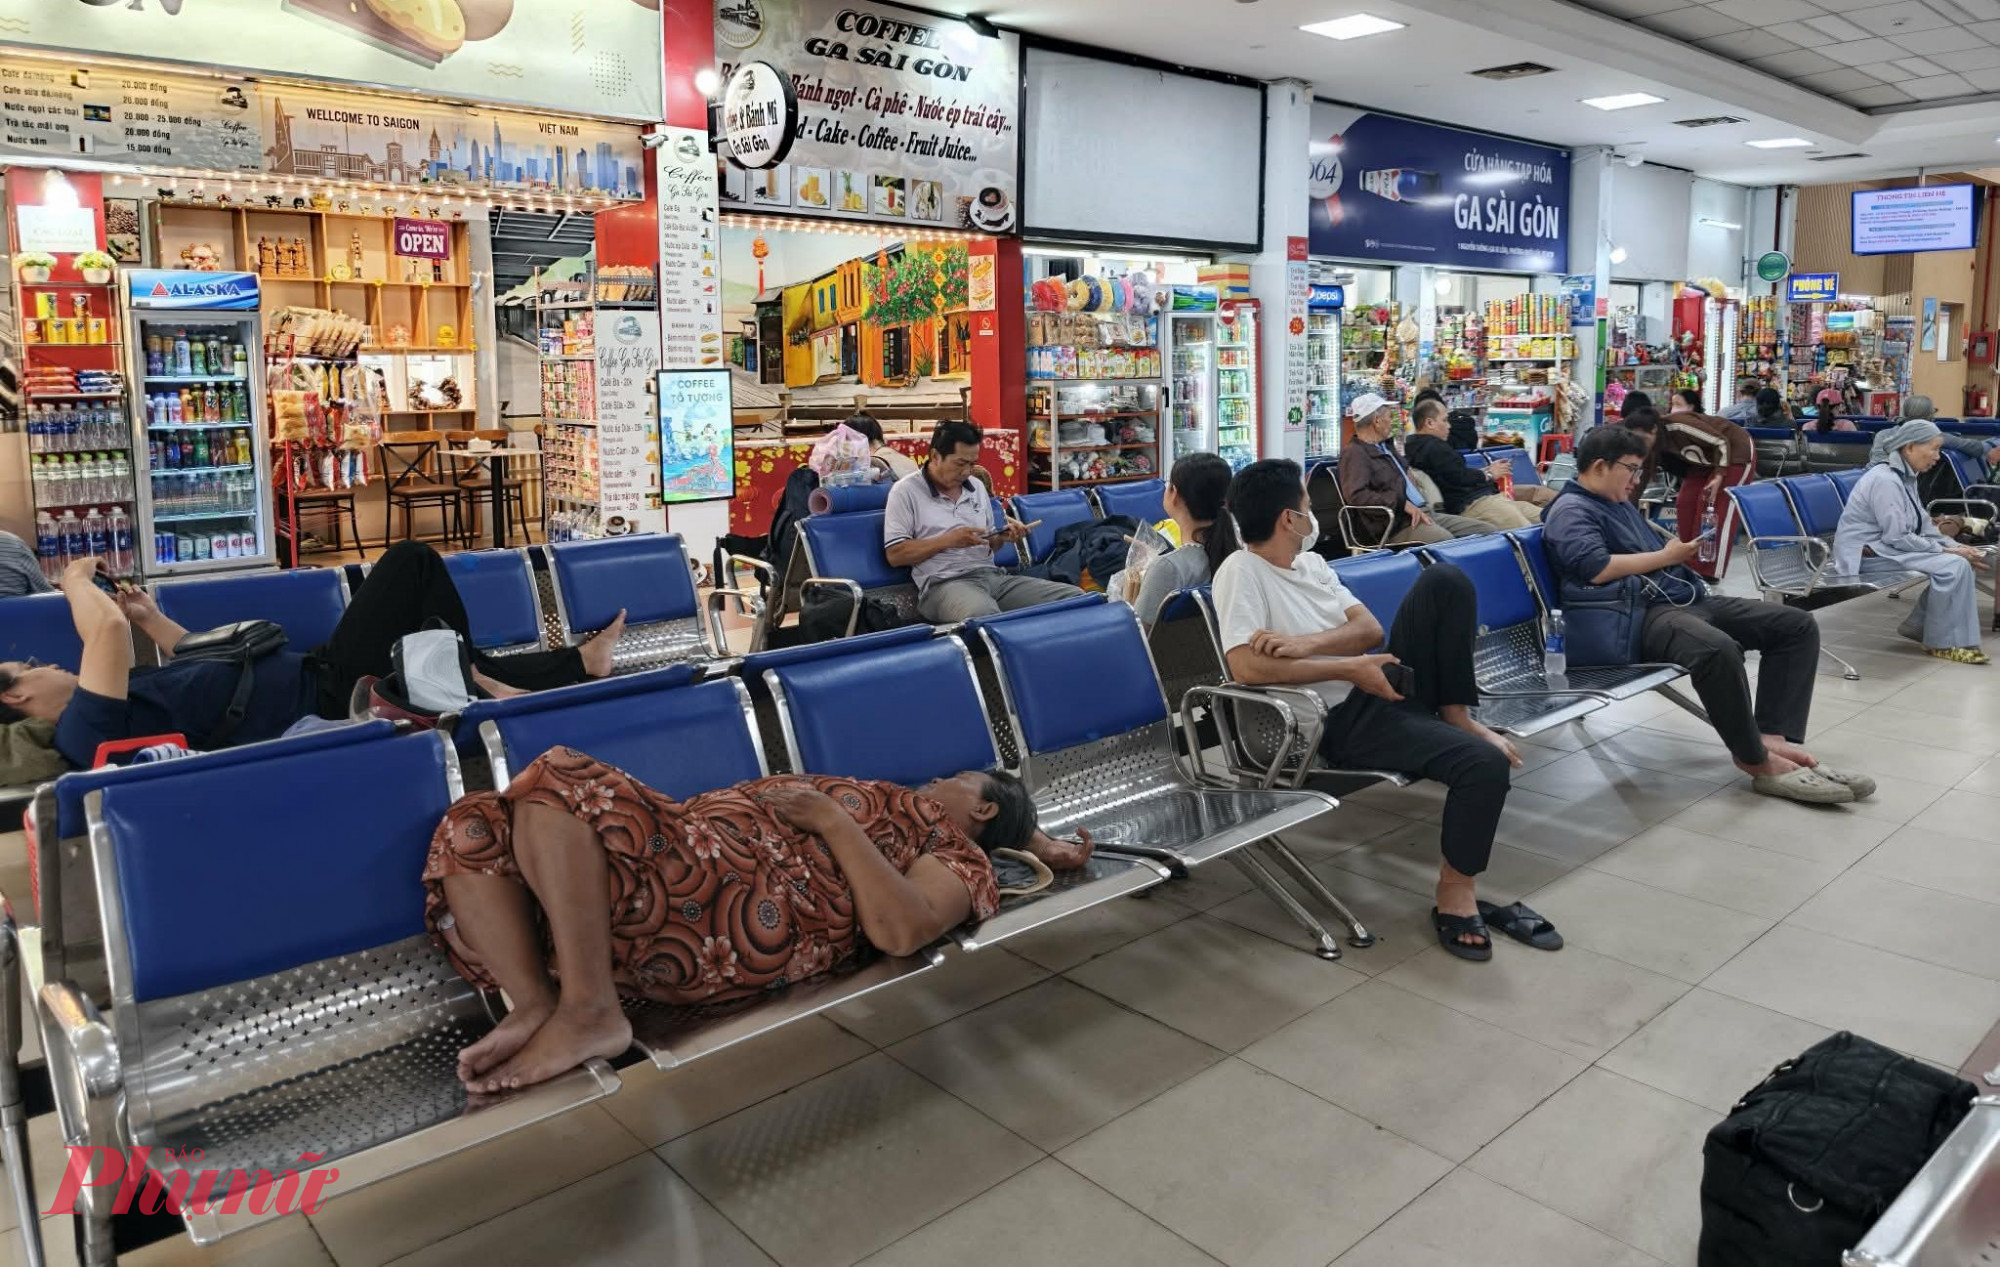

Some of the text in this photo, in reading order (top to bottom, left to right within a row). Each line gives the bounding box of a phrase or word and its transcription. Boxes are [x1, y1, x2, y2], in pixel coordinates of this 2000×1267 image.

[804, 36, 974, 84] GA SÀI GÒN
[123, 96, 148, 106] 20.000
[826, 86, 858, 114] ngọt
[865, 87, 883, 112] Cà
[881, 92, 908, 118] phê
[914, 95, 943, 121] Nước
[946, 99, 961, 128] ép
[963, 103, 985, 127] trái
[124, 111, 149, 121] 20.000
[157, 114, 182, 124] 25.000
[306, 107, 421, 131] WELLCOME TO SAIGON
[745, 100, 766, 128] Bánh
[152, 128, 171, 140] đồng
[538, 121, 579, 137] VIỆT NAM
[153, 144, 172, 155] đồng
[752, 133, 771, 152] Gòn
[815, 118, 849, 145] Cake
[858, 124, 899, 151] Coffee
[906, 131, 938, 157] Fruit
[939, 135, 977, 162] Juice...
[663, 165, 713, 185] Coffee
[1464, 147, 1484, 173] CỬA
[1533, 162, 1552, 184] HÓA
[1454, 189, 1559, 239] GA SÀI GÒN
[400, 232, 444, 253] OPEN
[171, 282, 241, 296] ALASKA
[1316, 290, 1338, 301] pepsi
[677, 379, 716, 389] COFFEE
